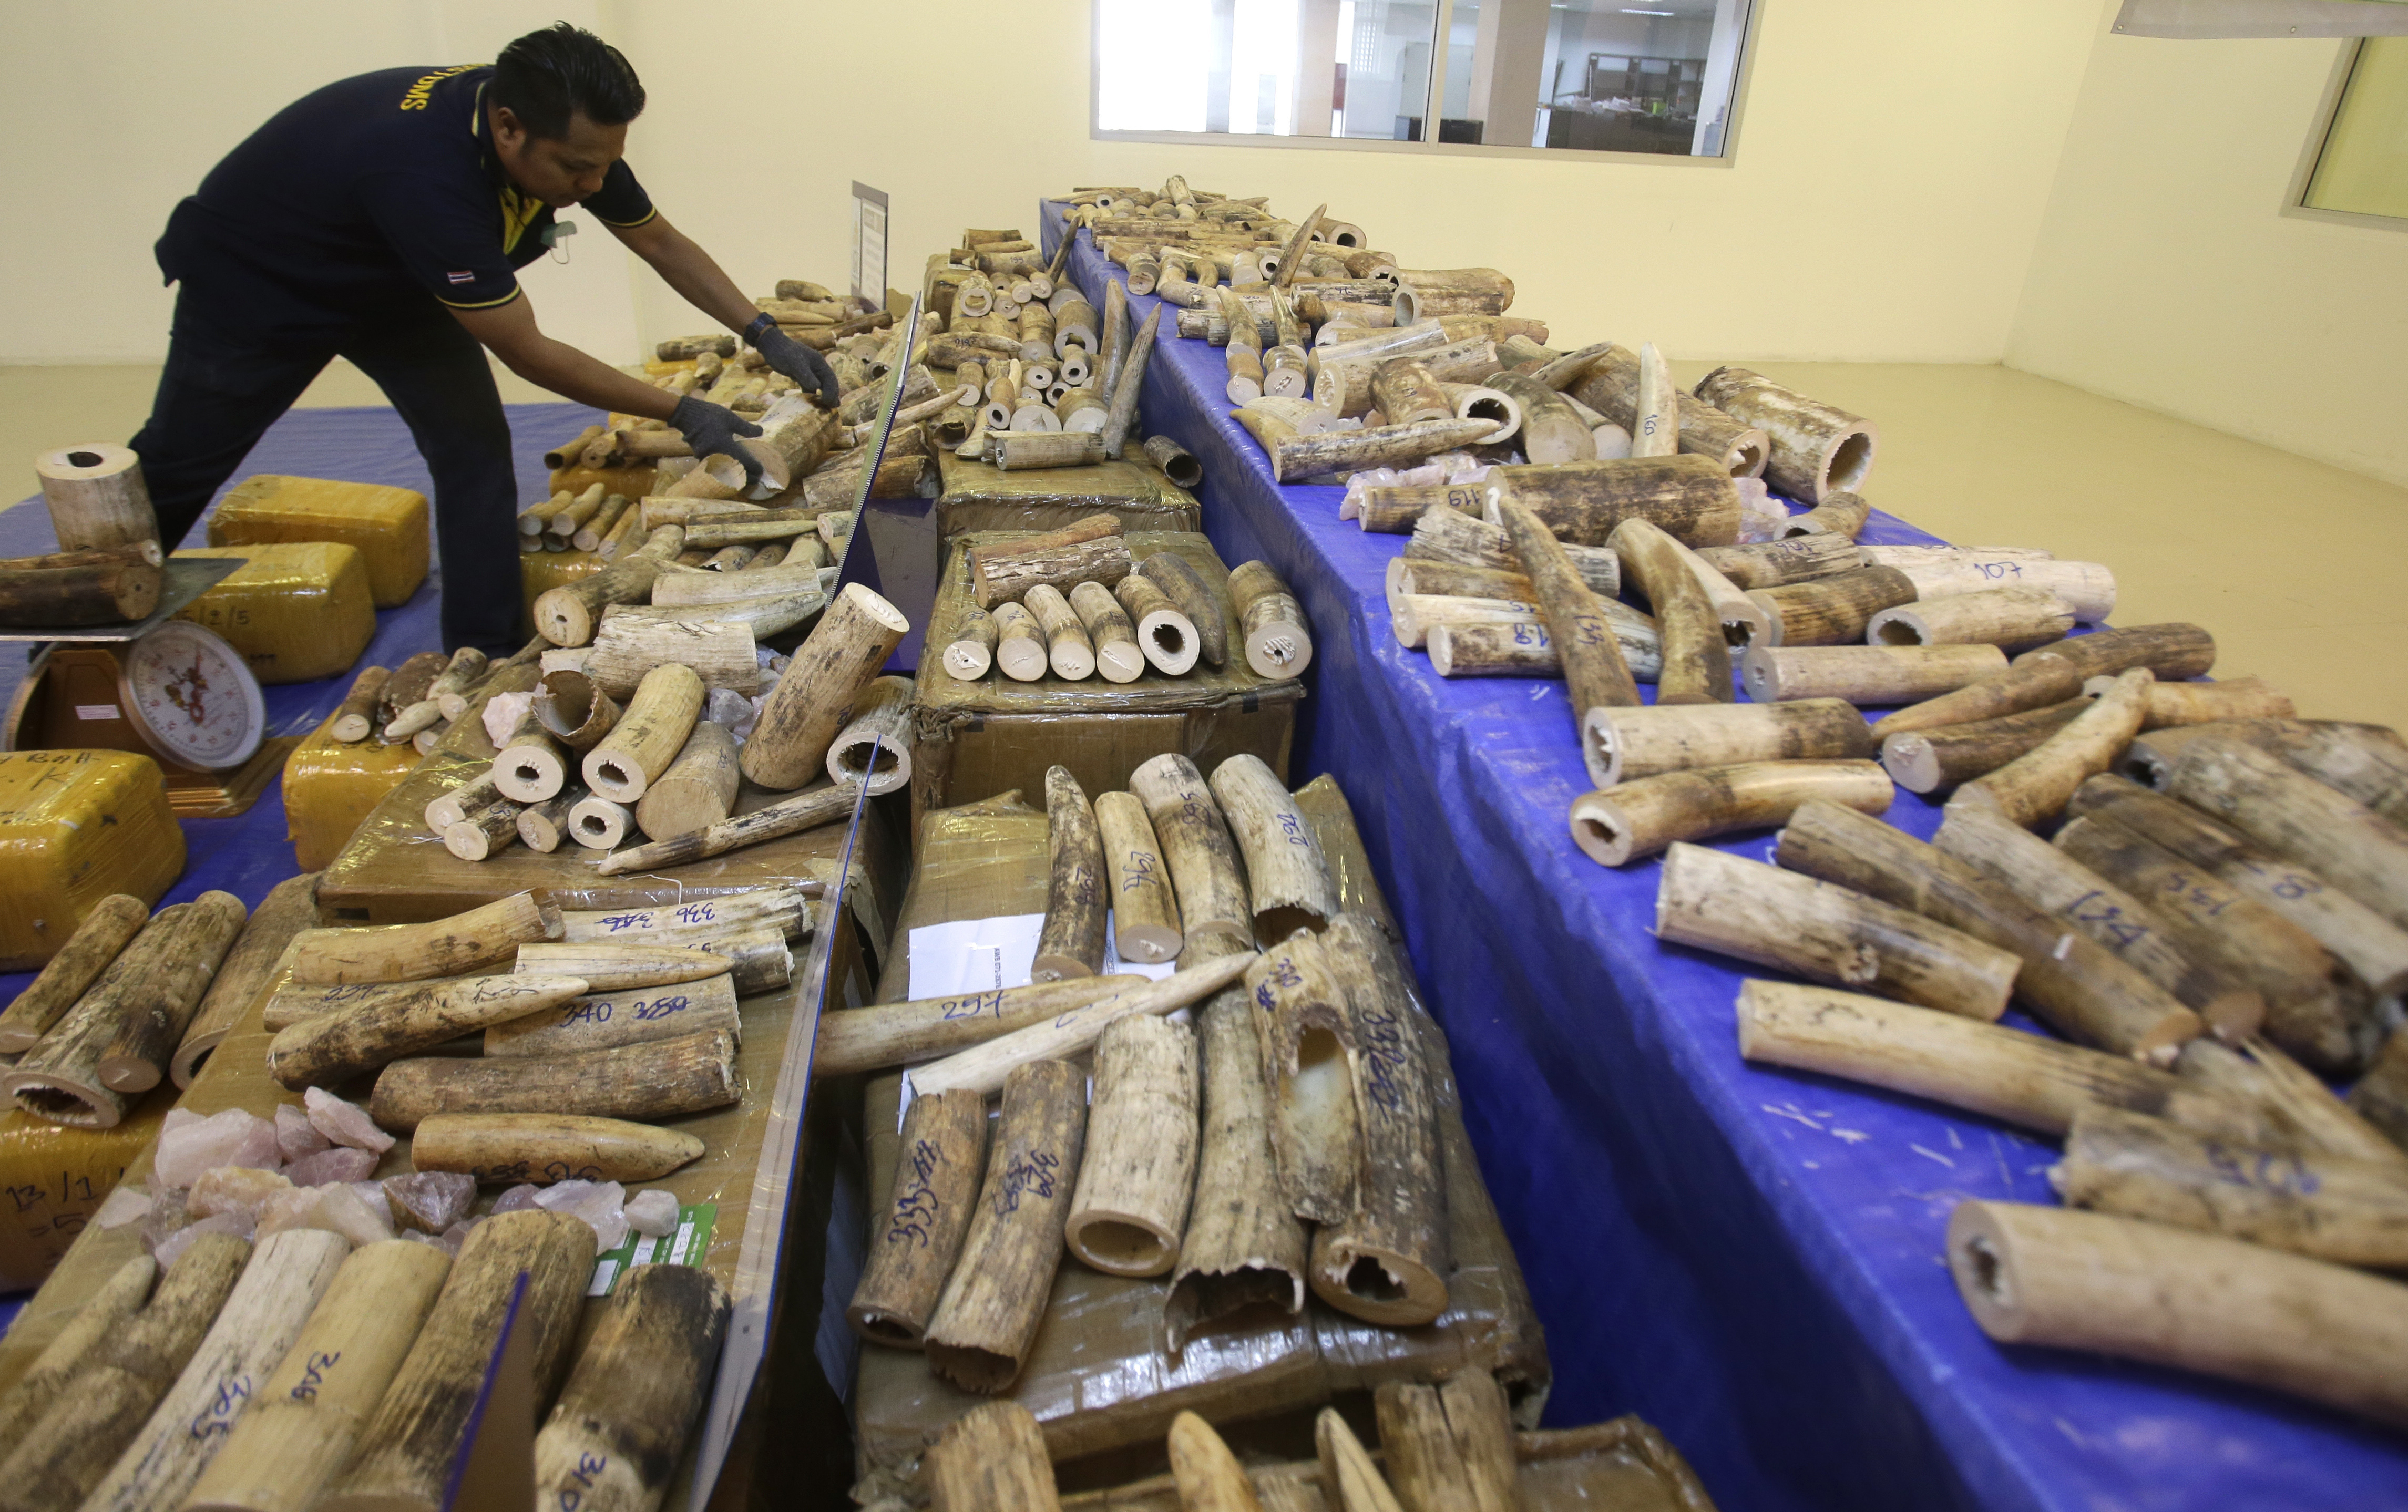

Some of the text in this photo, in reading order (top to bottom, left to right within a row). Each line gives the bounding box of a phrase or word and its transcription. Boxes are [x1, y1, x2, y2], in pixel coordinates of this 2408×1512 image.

[1644, 414, 1658, 436] 160
[1448, 488, 1481, 506] 119
[1974, 561, 2022, 580] 107
[677, 903, 715, 923] 336
[560, 1002, 612, 1027] 340
